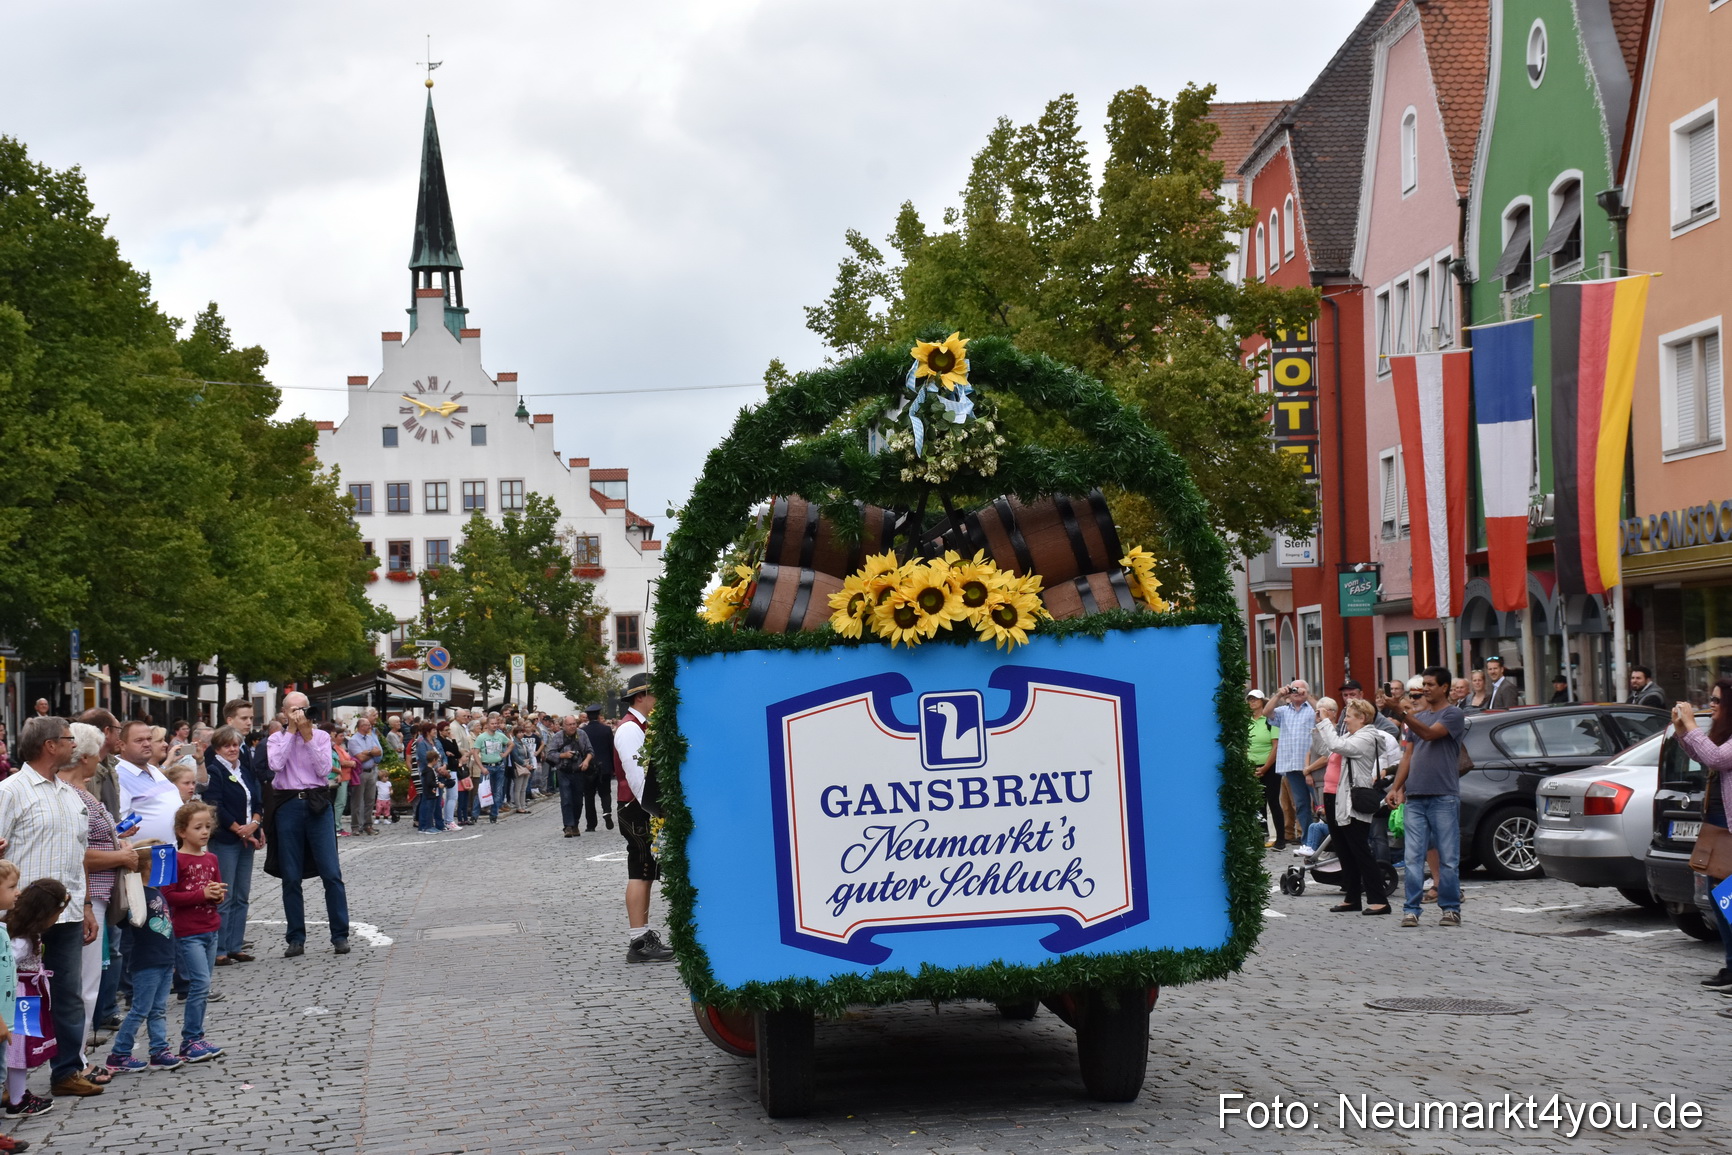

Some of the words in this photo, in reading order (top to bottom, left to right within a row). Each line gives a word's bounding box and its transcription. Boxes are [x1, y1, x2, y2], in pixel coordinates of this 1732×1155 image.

[1273, 315, 1312, 514] HOTE
[1284, 539, 1311, 549] Stern
[1344, 579, 1359, 589] vom
[1350, 581, 1372, 595] FASS
[820, 770, 1093, 818] GANSBRÄU
[840, 815, 1076, 874] Neumarkt's
[825, 871, 931, 917] guter
[926, 856, 1096, 908] Schluck
